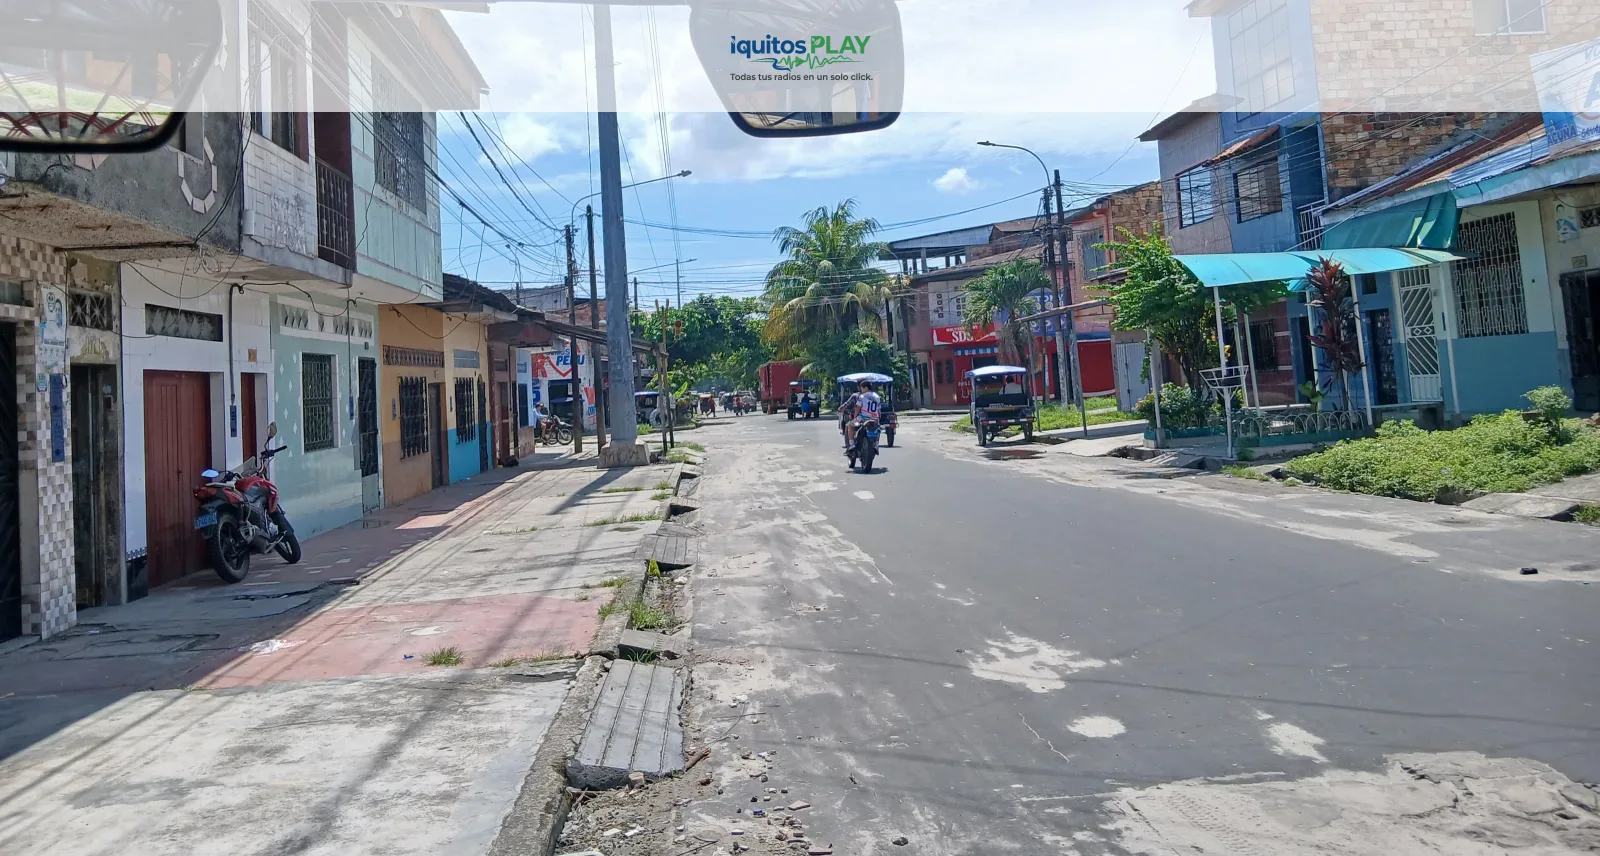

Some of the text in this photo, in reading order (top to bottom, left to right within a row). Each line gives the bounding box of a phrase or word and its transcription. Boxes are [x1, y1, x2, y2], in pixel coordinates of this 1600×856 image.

[1547, 124, 1578, 146] ACUÑA
[556, 354, 585, 366] PEU
[867, 400, 877, 412] 10
